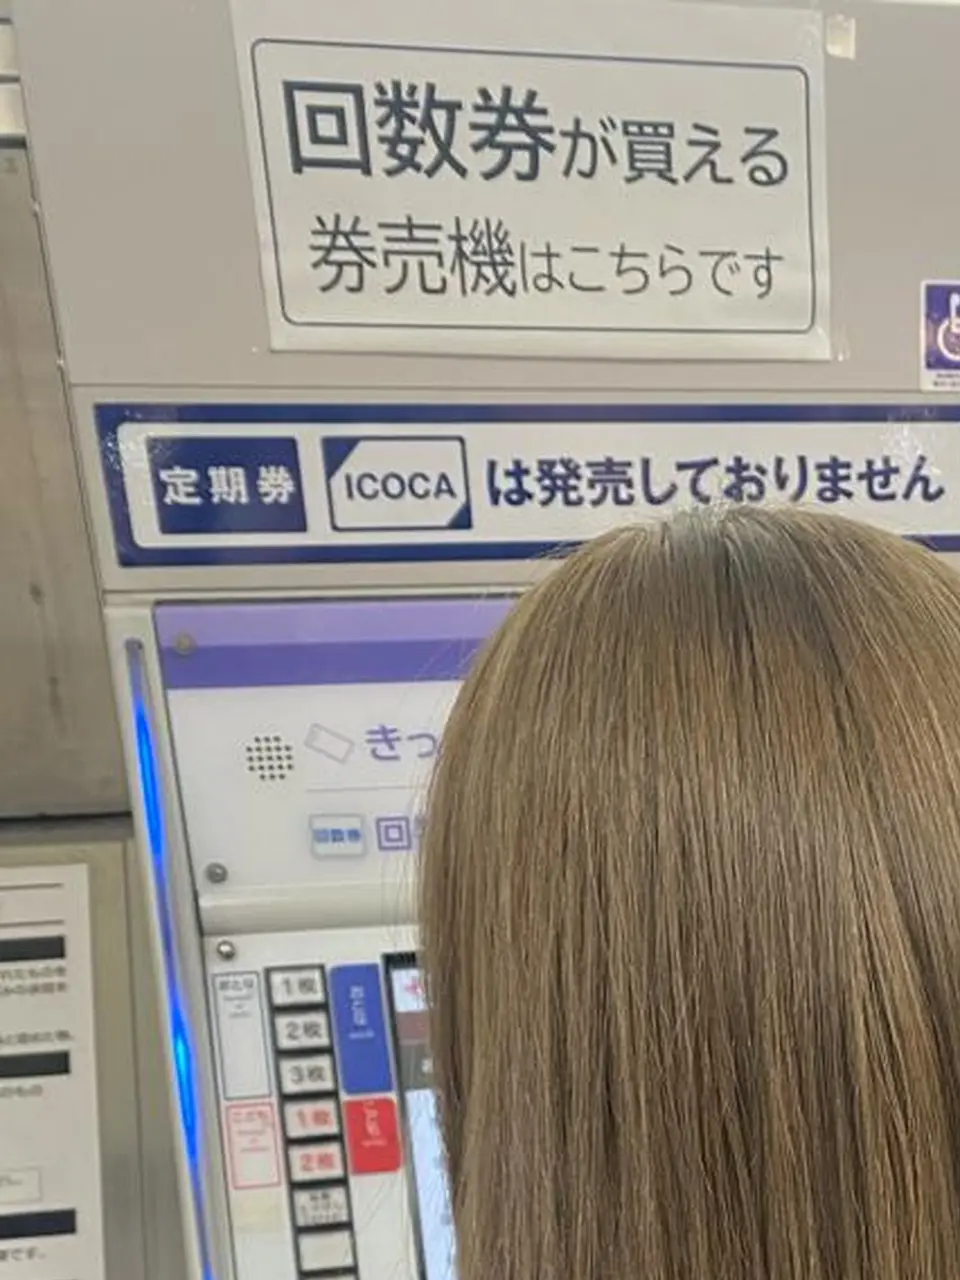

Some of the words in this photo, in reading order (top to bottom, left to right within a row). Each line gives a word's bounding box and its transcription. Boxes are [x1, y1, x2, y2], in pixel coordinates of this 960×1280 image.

[283, 80, 790, 186] 回数券が買える
[309, 213, 785, 299] 券売機はこちらです
[159, 464, 297, 505] 定期券
[346, 471, 457, 500] ICOCA
[487, 455, 945, 508] は発売しておりません
[366, 724, 438, 761] きっ
[286, 1021, 323, 1040] 2枚
[290, 1064, 326, 1083] 3枚
